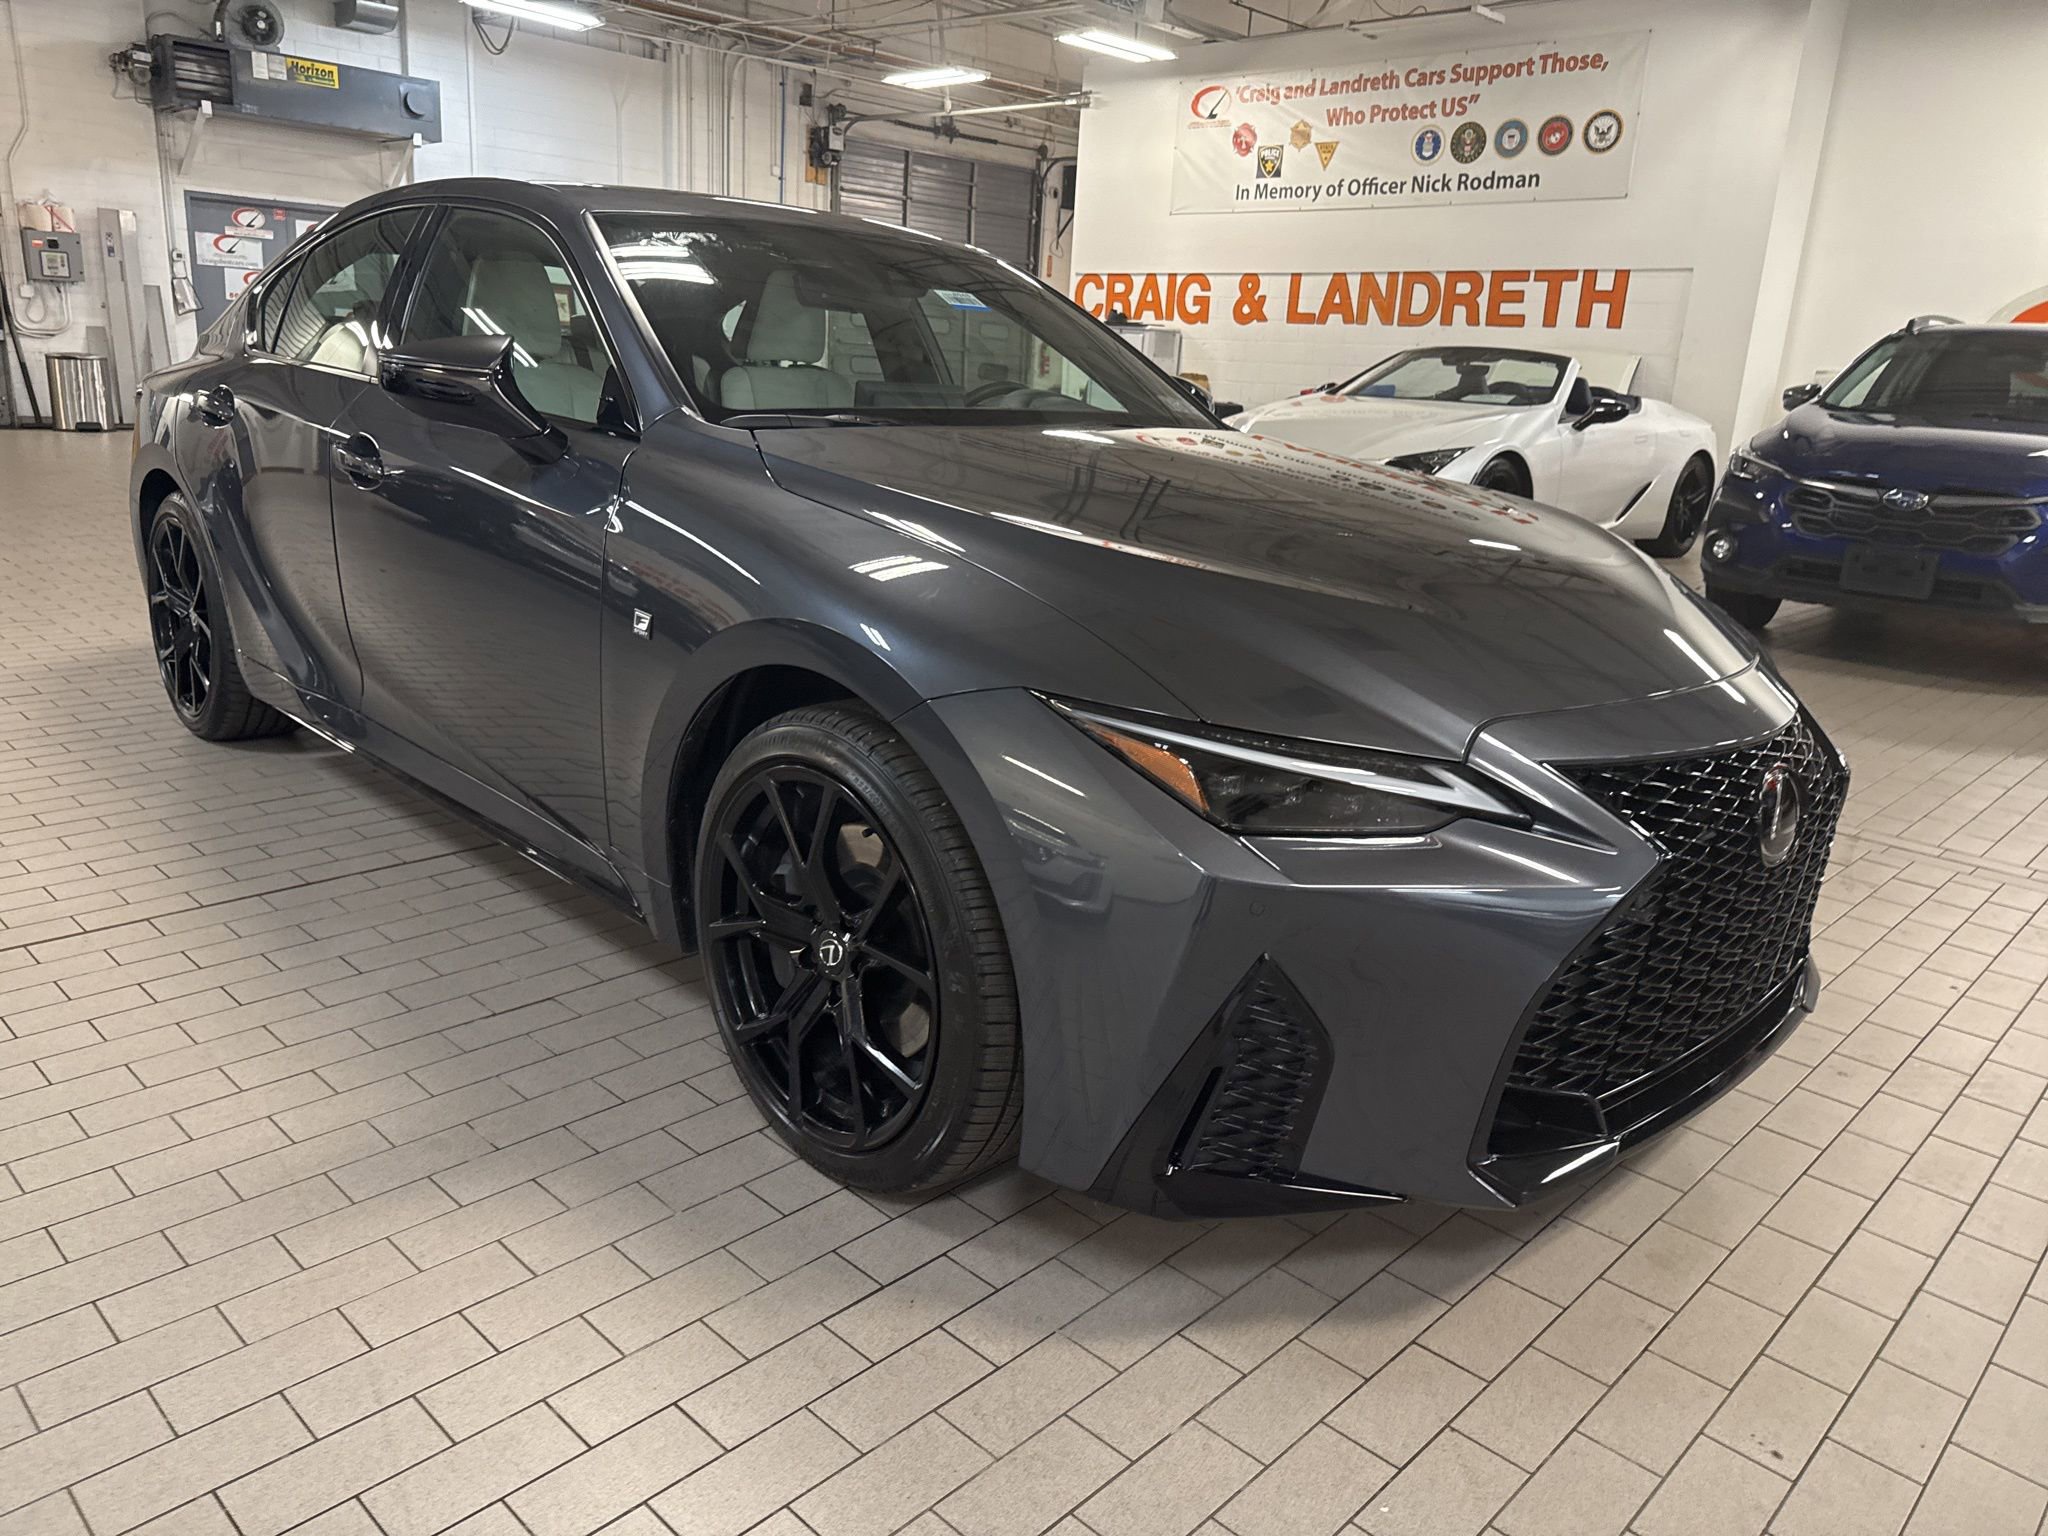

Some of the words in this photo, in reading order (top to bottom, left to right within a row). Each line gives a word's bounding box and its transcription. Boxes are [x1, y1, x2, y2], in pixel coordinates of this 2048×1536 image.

[290, 60, 334, 79] Horizon
[1284, 78, 1316, 100] and
[1319, 70, 1400, 96] Landreth
[1404, 68, 1445, 87] Cars
[1450, 56, 1535, 86] Support
[1539, 52, 1609, 75] Those,
[1326, 105, 1366, 126] Who
[1369, 101, 1437, 123] Protect
[1235, 184, 1250, 200] In
[1254, 183, 1322, 203] Memory
[1326, 178, 1345, 197] of
[1347, 177, 1407, 196] Officer
[1411, 173, 1452, 194] Nick
[1457, 170, 1541, 191] Rodman
[1074, 273, 1211, 325] CRAIG
[1232, 273, 1268, 325] &
[1286, 269, 1631, 329] LANDRETH
